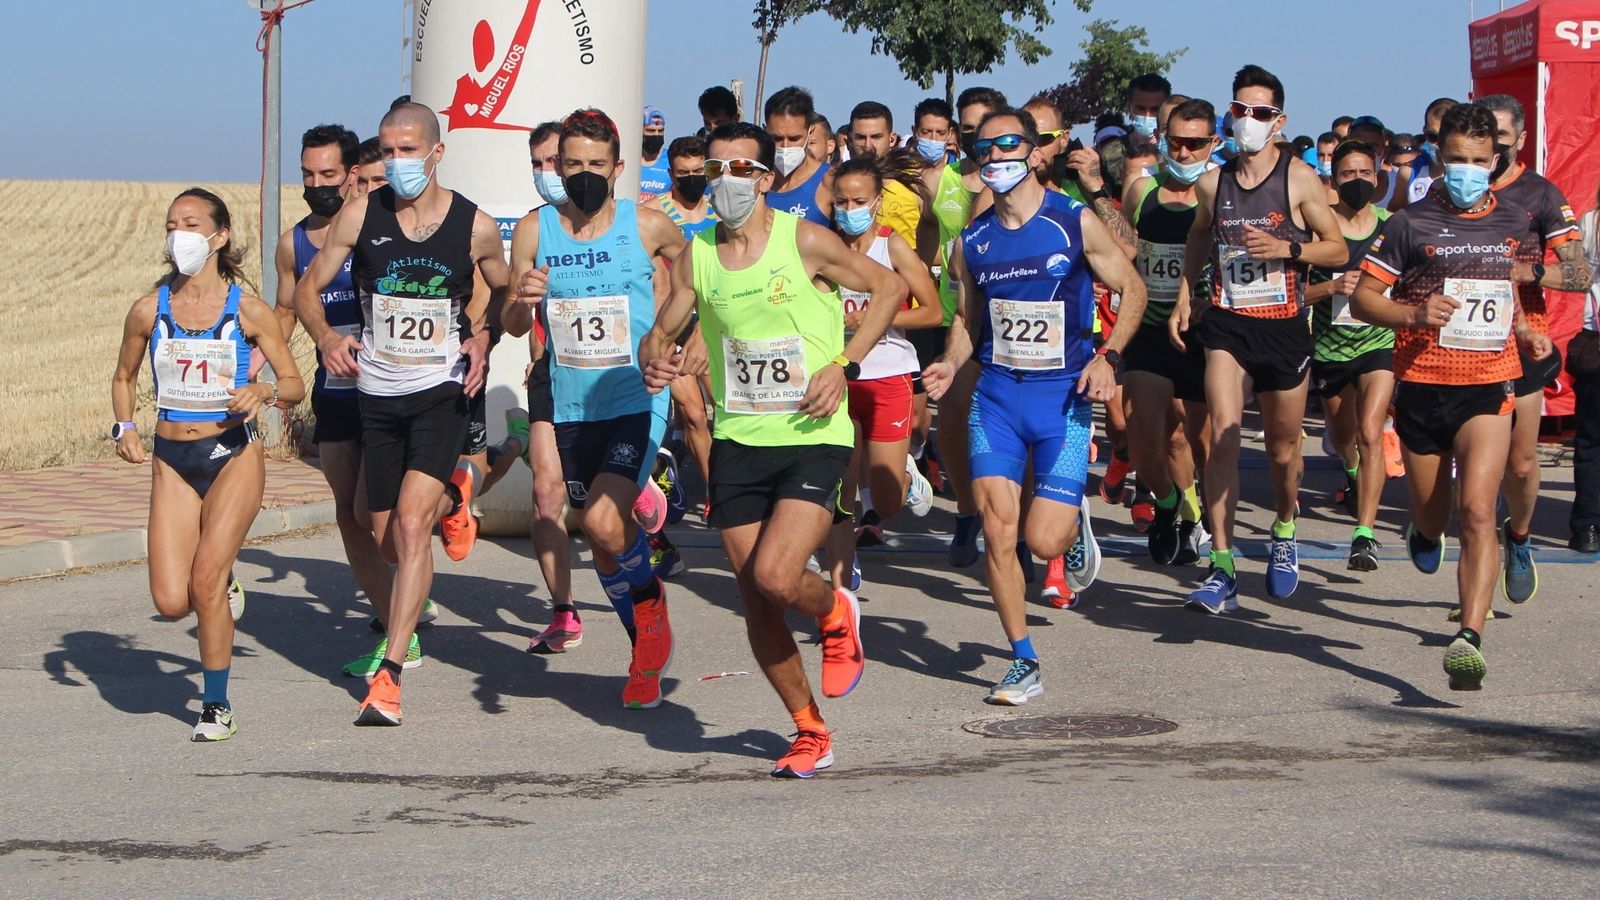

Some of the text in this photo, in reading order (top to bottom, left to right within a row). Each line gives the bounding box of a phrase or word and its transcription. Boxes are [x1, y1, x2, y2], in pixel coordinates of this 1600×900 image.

[562, 0, 594, 64] ETISMO
[479, 44, 525, 118] MIGUEL RIOS
[545, 248, 611, 269] nerja
[1425, 243, 1511, 258] Deporteando
[392, 257, 452, 276] Atletismo
[555, 269, 603, 280] ATLETISMO
[989, 267, 1037, 281] Montellano
[1143, 257, 1181, 279] 146
[1227, 262, 1268, 284] 151
[1466, 298, 1497, 323] 76
[385, 315, 434, 341] 120
[570, 316, 605, 342] 13
[1000, 317, 1049, 342] 222
[1453, 329, 1482, 337] CEJUDO
[384, 344, 407, 353] ARCAS
[1008, 348, 1045, 356] ARENILLAS
[176, 359, 208, 384] 71
[735, 358, 790, 385] 378
[782, 390, 806, 398] ROSA
